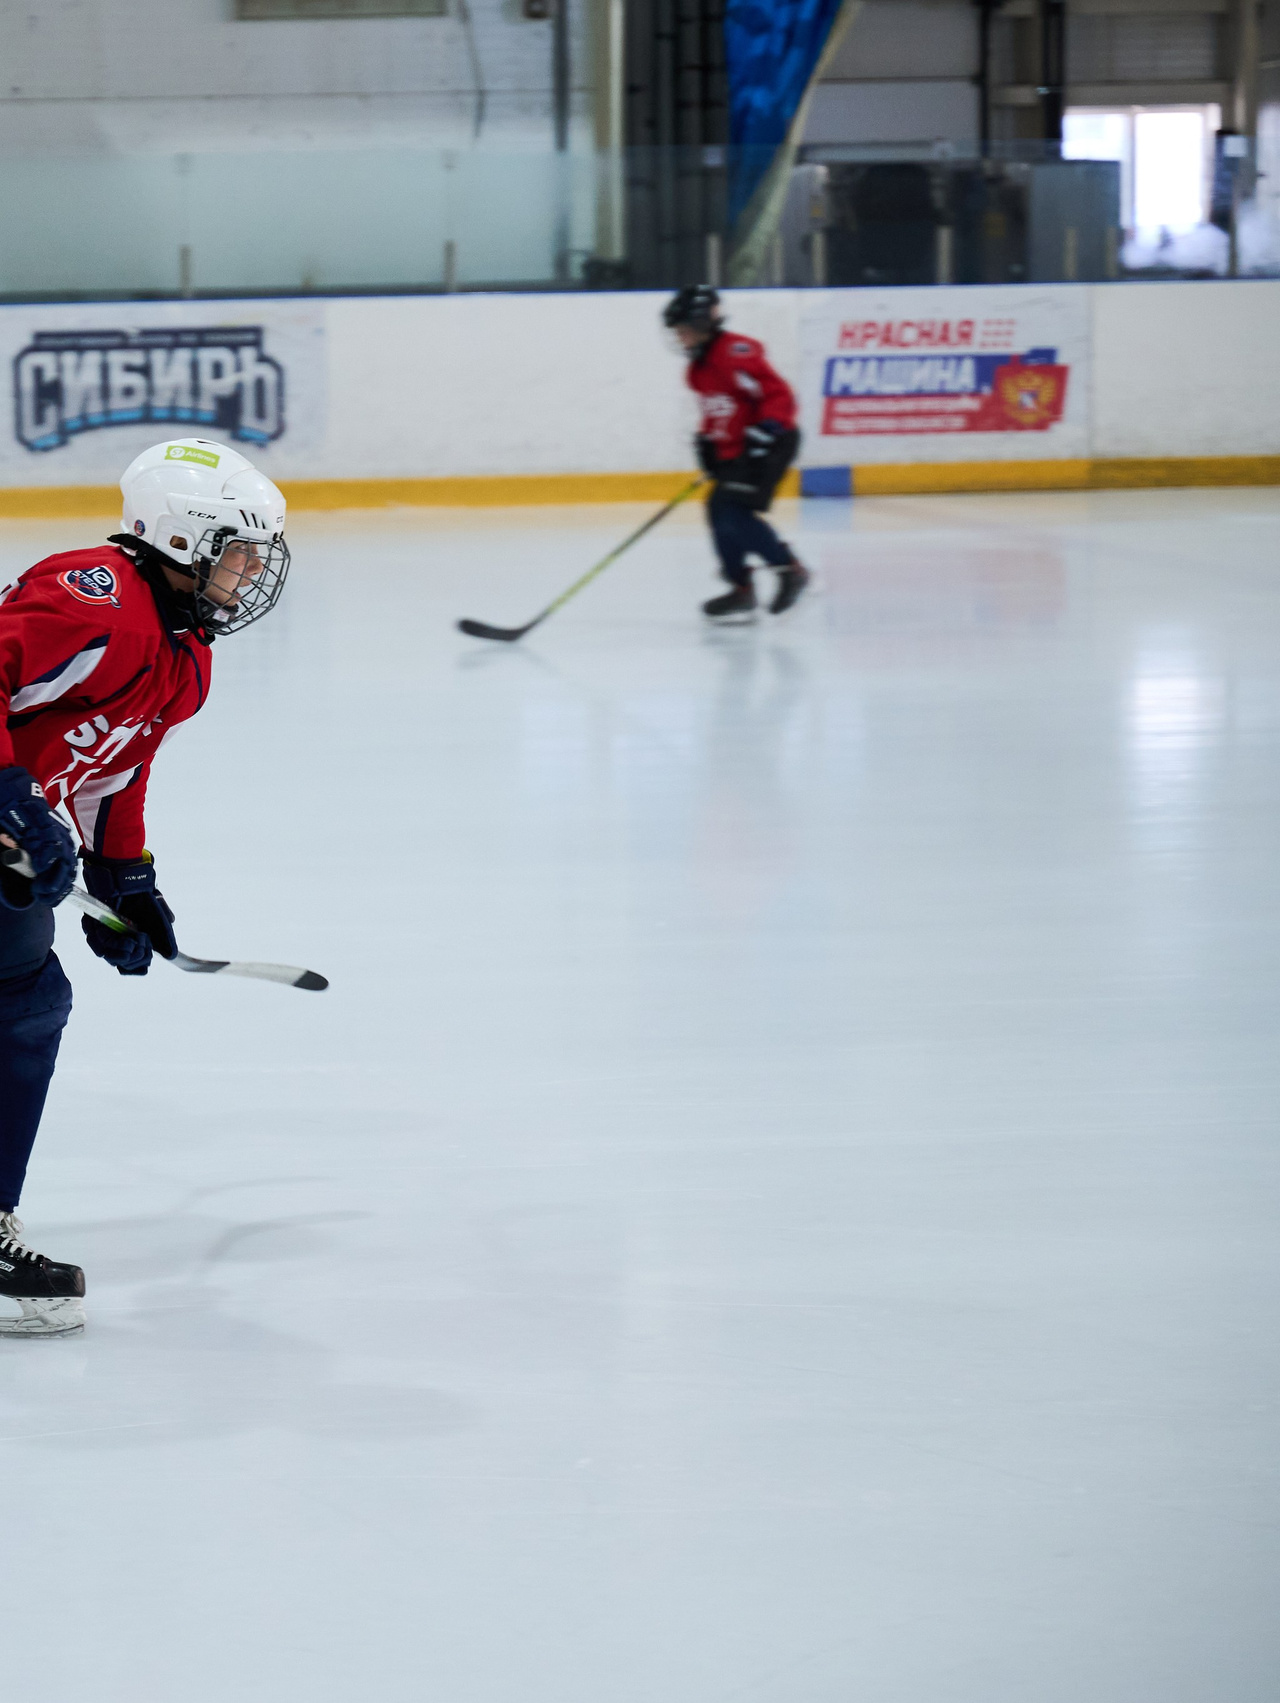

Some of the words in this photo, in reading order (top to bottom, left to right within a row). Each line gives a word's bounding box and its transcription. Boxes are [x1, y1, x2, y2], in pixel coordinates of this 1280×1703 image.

[186, 450, 216, 463] Airlines
[187, 510, 217, 520] CCM
[71, 570, 103, 596] STEPS
[86, 566, 112, 586] 10
